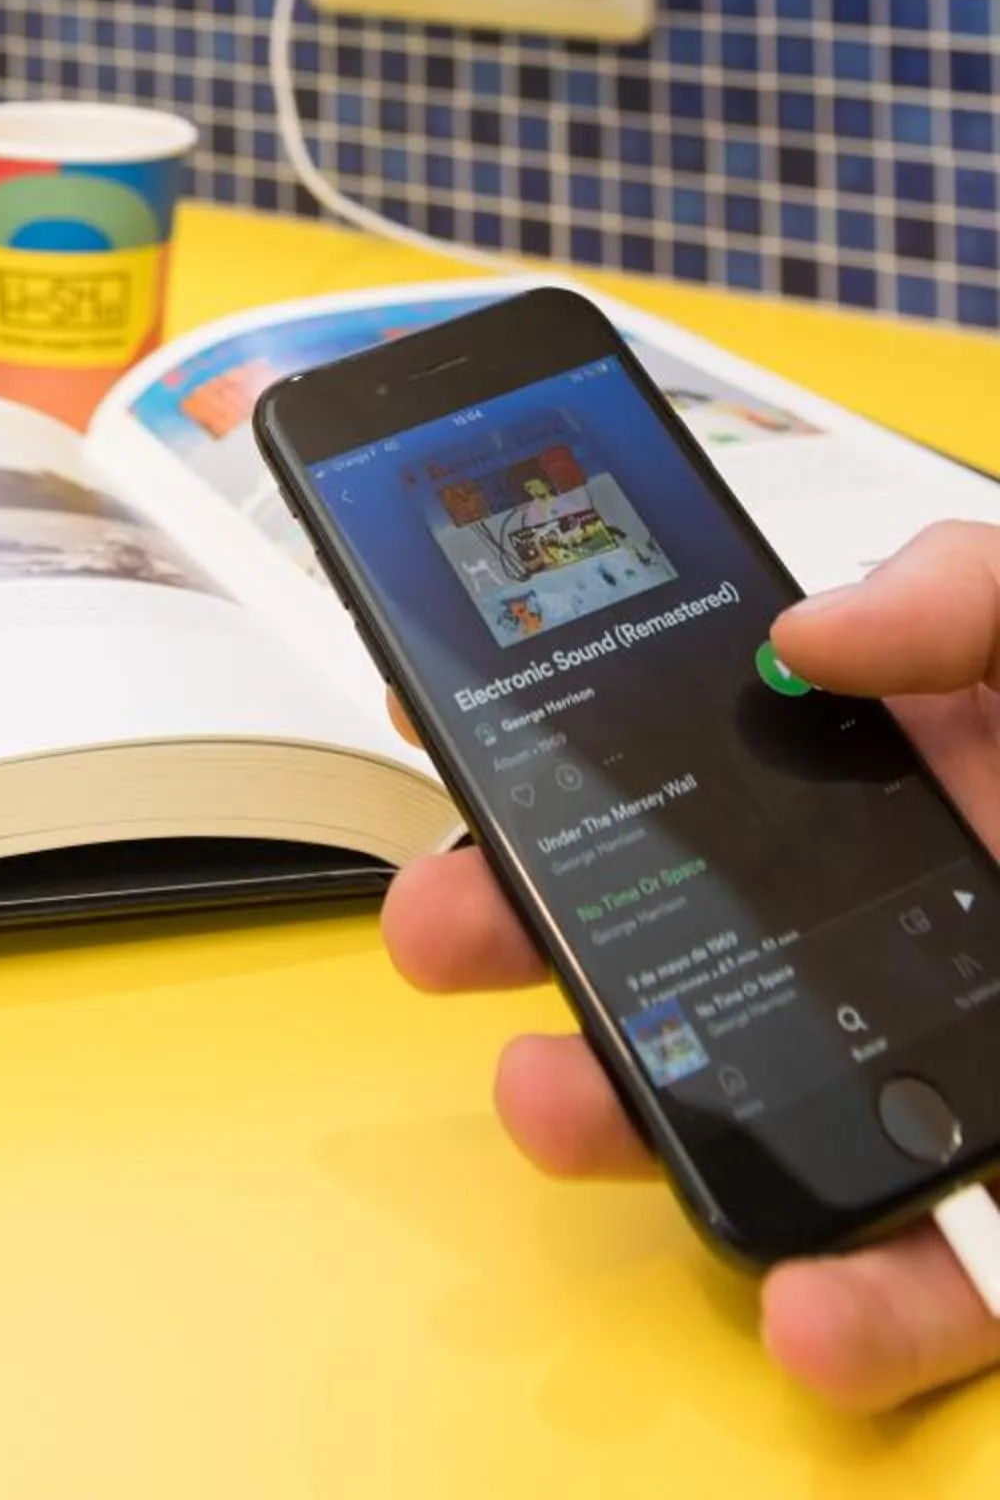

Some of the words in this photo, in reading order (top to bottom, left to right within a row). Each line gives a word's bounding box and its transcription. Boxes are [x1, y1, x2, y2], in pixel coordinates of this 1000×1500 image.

[453, 661, 554, 712] Electronic
[552, 633, 618, 673] Sound
[614, 580, 740, 649] (Remastered)
[501, 703, 545, 733] George
[546, 686, 595, 715] Harrison
[537, 827, 582, 855] Under
[580, 813, 612, 835] The
[609, 789, 665, 825] Mersey
[662, 772, 698, 799] Wall
[575, 904, 604, 924] No
[601, 886, 641, 913] Time
[638, 876, 661, 896] Or
[659, 856, 708, 887] Space
